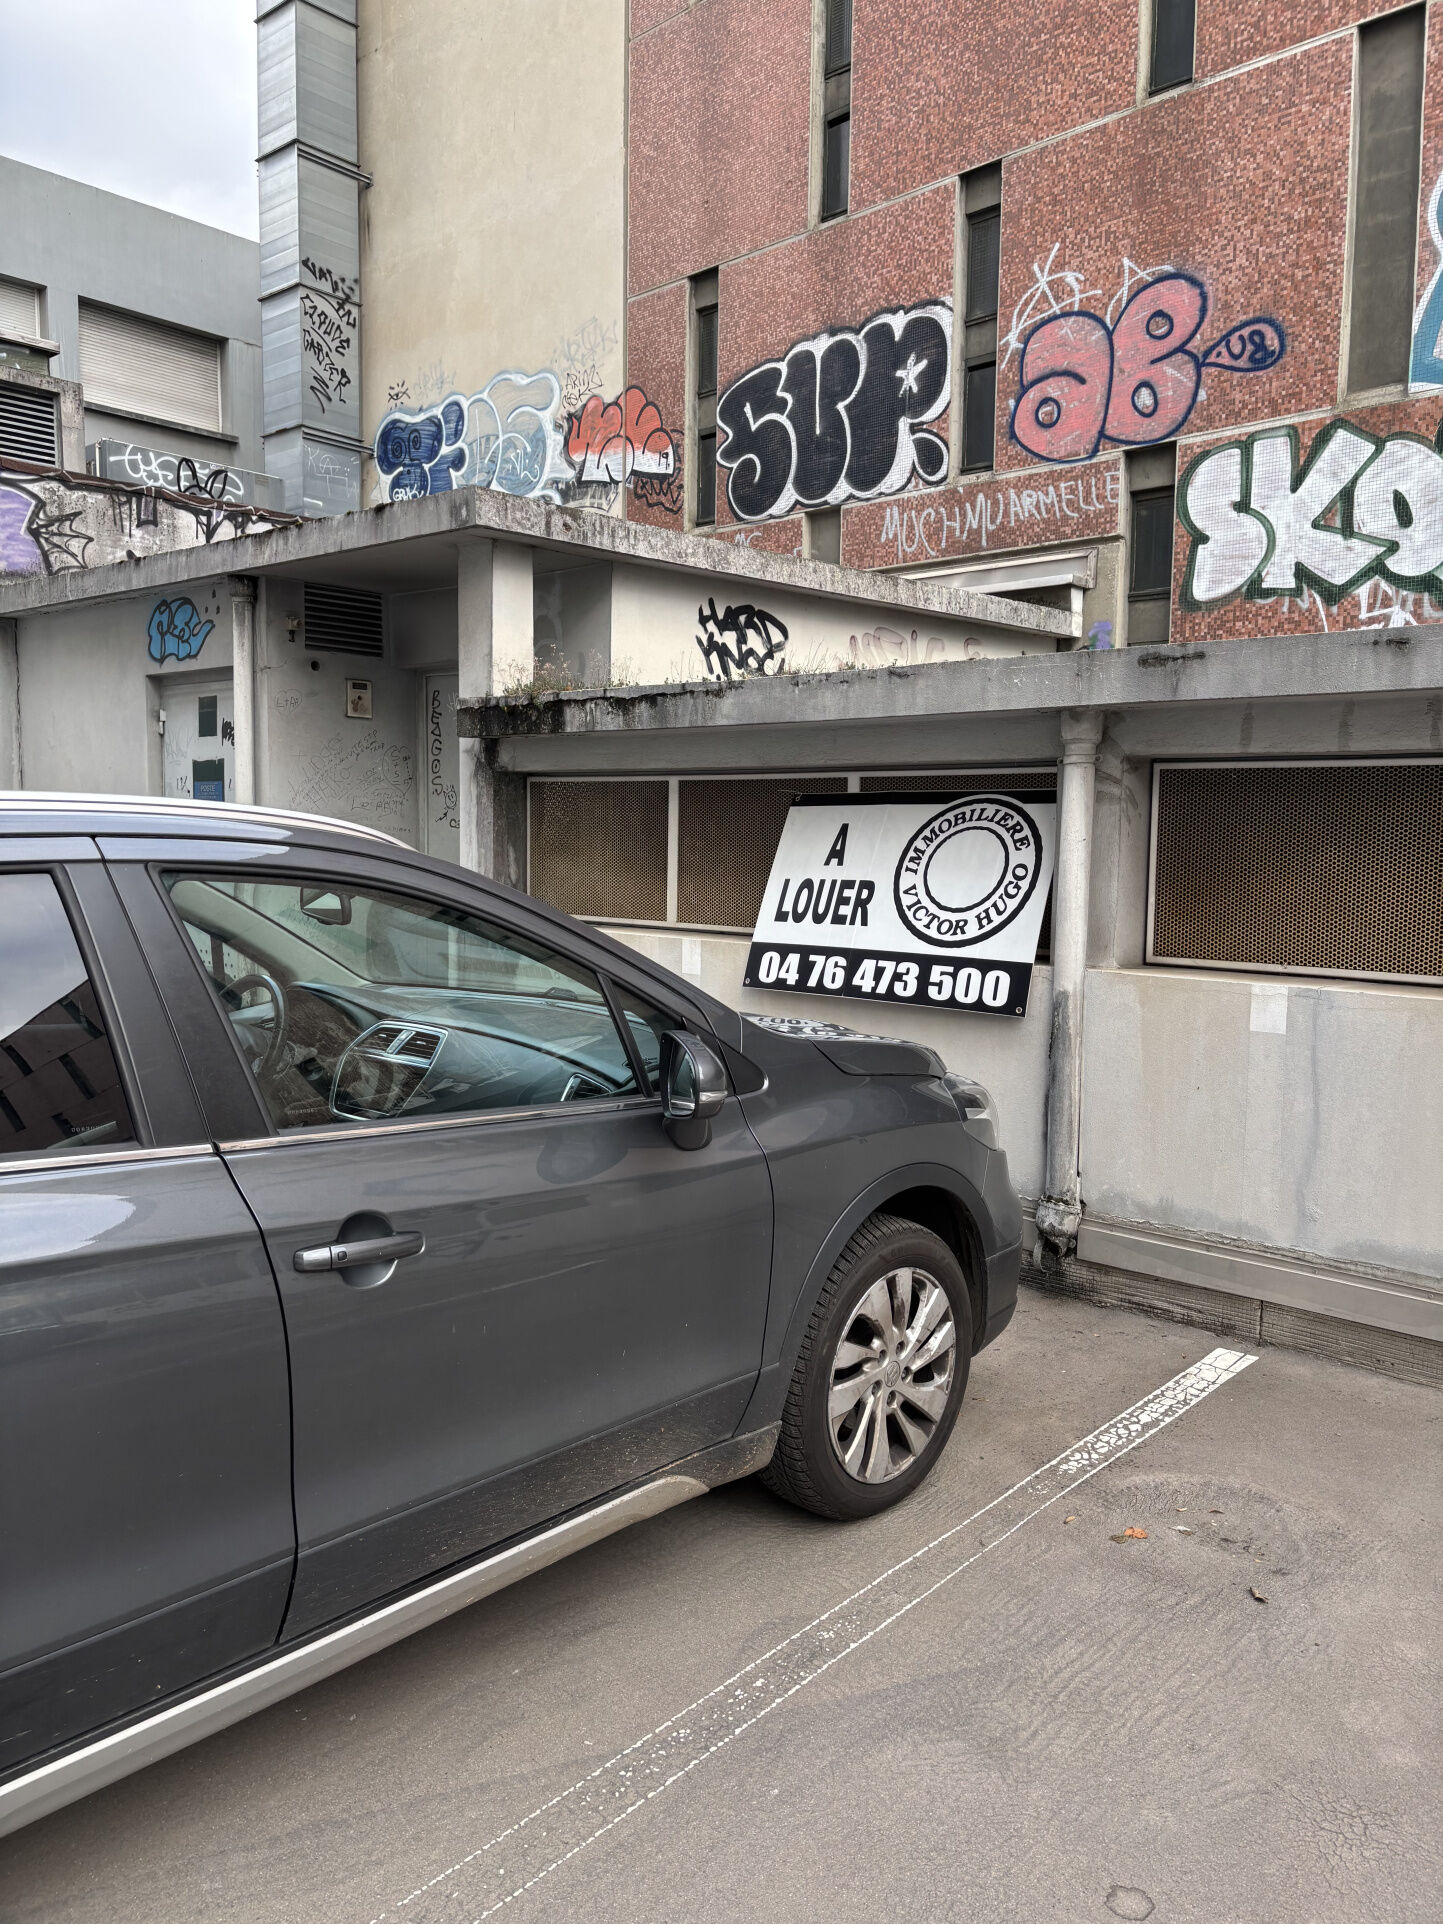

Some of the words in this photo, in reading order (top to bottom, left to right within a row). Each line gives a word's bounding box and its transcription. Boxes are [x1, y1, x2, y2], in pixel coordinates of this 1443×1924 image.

[823, 823, 849, 867] A
[905, 807, 1031, 876] IMMOBILIERE
[774, 878, 875, 926] LOUER
[905, 883, 968, 936] VICTOR
[976, 862, 1029, 930] HUGO
[758, 951, 802, 985] 04
[806, 954, 847, 990] 76
[852, 958, 920, 998] 473
[927, 965, 1011, 1007] 500
